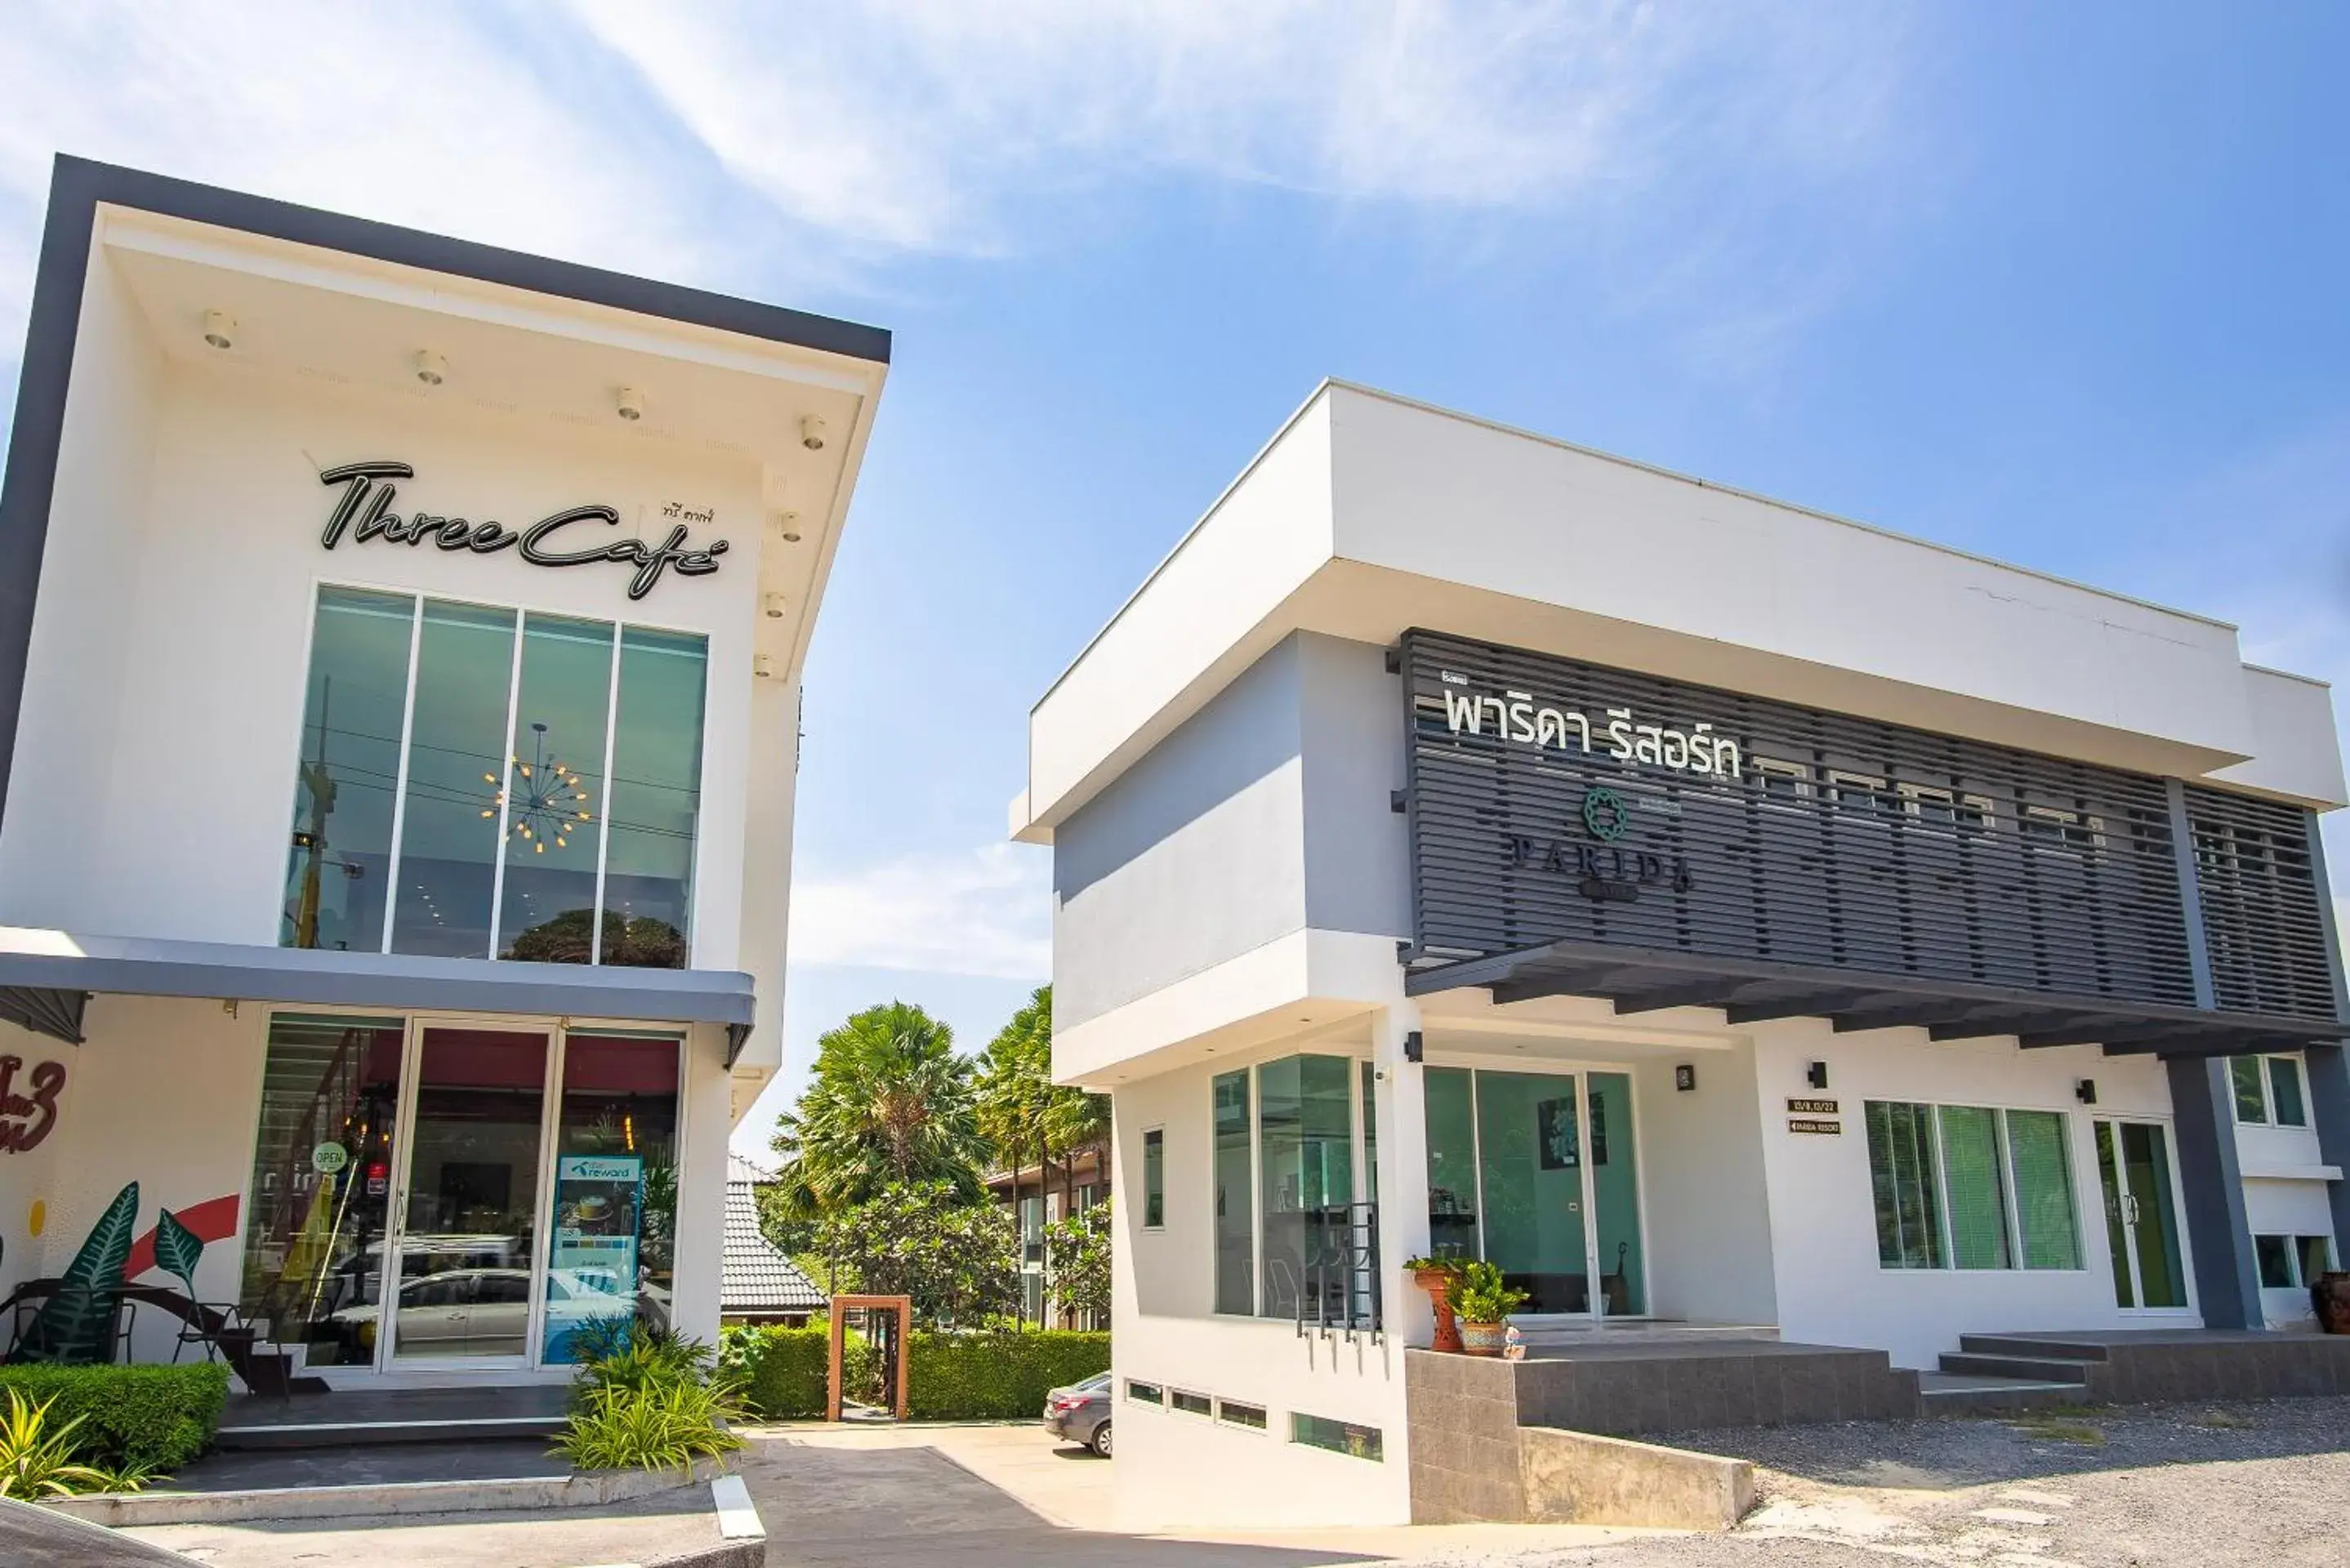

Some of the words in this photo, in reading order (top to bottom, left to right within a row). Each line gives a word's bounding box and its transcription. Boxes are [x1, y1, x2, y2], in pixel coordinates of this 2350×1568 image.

[321, 461, 519, 550] Three
[518, 506, 730, 600] Café
[1443, 689, 1591, 753] พาริดา
[1606, 706, 1741, 778] รีสอร์ท
[1511, 837, 1695, 893] PARIDA
[315, 1152, 343, 1164] OPEN
[588, 1168, 629, 1177] reward
